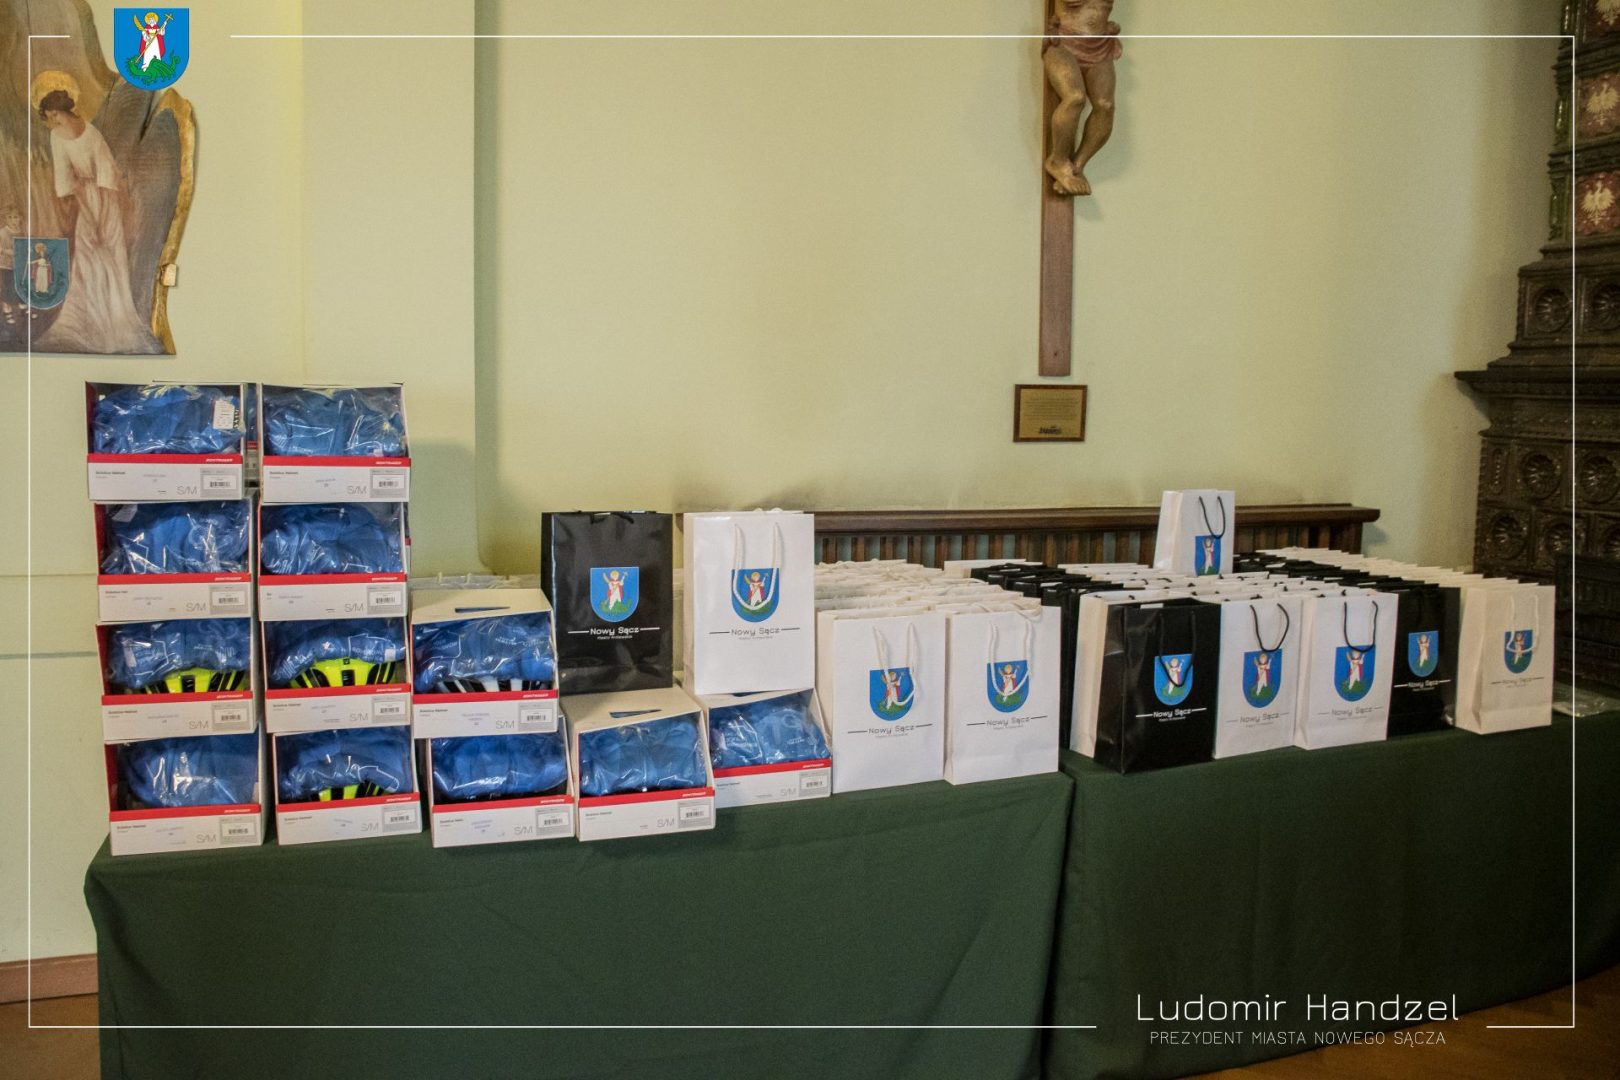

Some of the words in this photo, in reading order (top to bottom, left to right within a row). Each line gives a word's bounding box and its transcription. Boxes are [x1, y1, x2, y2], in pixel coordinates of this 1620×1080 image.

[177, 486, 197, 495] S/M
[348, 485, 367, 495] S/M
[186, 602, 206, 612] S/M
[345, 603, 364, 613] S/M
[590, 627, 615, 636] Nowy
[618, 626, 640, 635] Sącz
[731, 628, 756, 636] Nowy
[759, 627, 780, 635] Sącz
[350, 712, 369, 722] S/M
[1153, 710, 1173, 718] Nowy
[189, 720, 209, 730] S/M
[495, 719, 515, 730] S/M
[986, 719, 1008, 727] Nowy
[868, 727, 892, 735] Nowy
[657, 818, 675, 828] S/M
[514, 825, 533, 835] S/M
[196, 833, 217, 844] S/M
